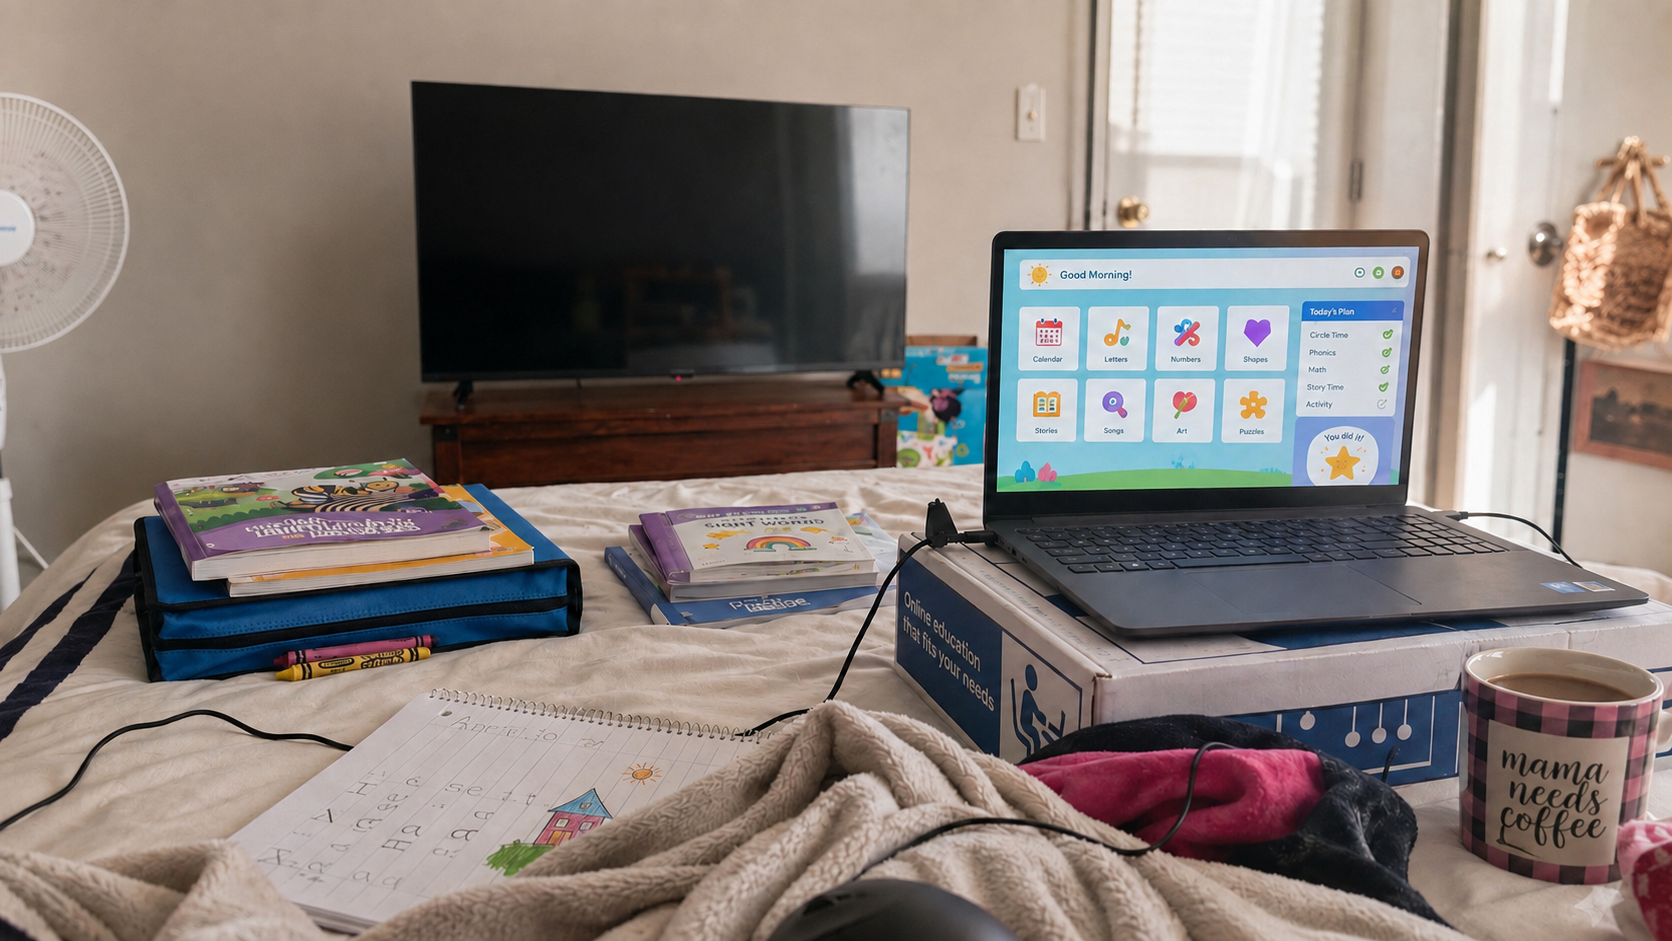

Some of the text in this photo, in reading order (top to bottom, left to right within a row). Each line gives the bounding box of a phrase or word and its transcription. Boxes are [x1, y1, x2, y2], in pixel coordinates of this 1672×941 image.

[1060, 269, 1132, 282] Good Morning!
[1309, 308, 1355, 317] Today's Plan
[1309, 331, 1349, 339] Circle Time
[1309, 349, 1337, 357] Phonics
[1032, 355, 1063, 363] Calendar
[1243, 355, 1269, 365] Shapes
[1308, 366, 1327, 374] Math
[1306, 383, 1345, 393] Story Time
[1305, 400, 1334, 410] Activity
[1034, 427, 1059, 435] Stories
[1103, 427, 1125, 436] Songs
[1176, 427, 1189, 435] Art
[1239, 428, 1266, 436] Puzzles
[1323, 431, 1366, 443] You did it!
[903, 590, 932, 627] Online
[933, 618, 981, 673] education
[902, 615, 996, 712] that fits your needs
[1501, 750, 1609, 785] mama
[1509, 781, 1608, 816] needs
[1499, 806, 1607, 853] coffee
